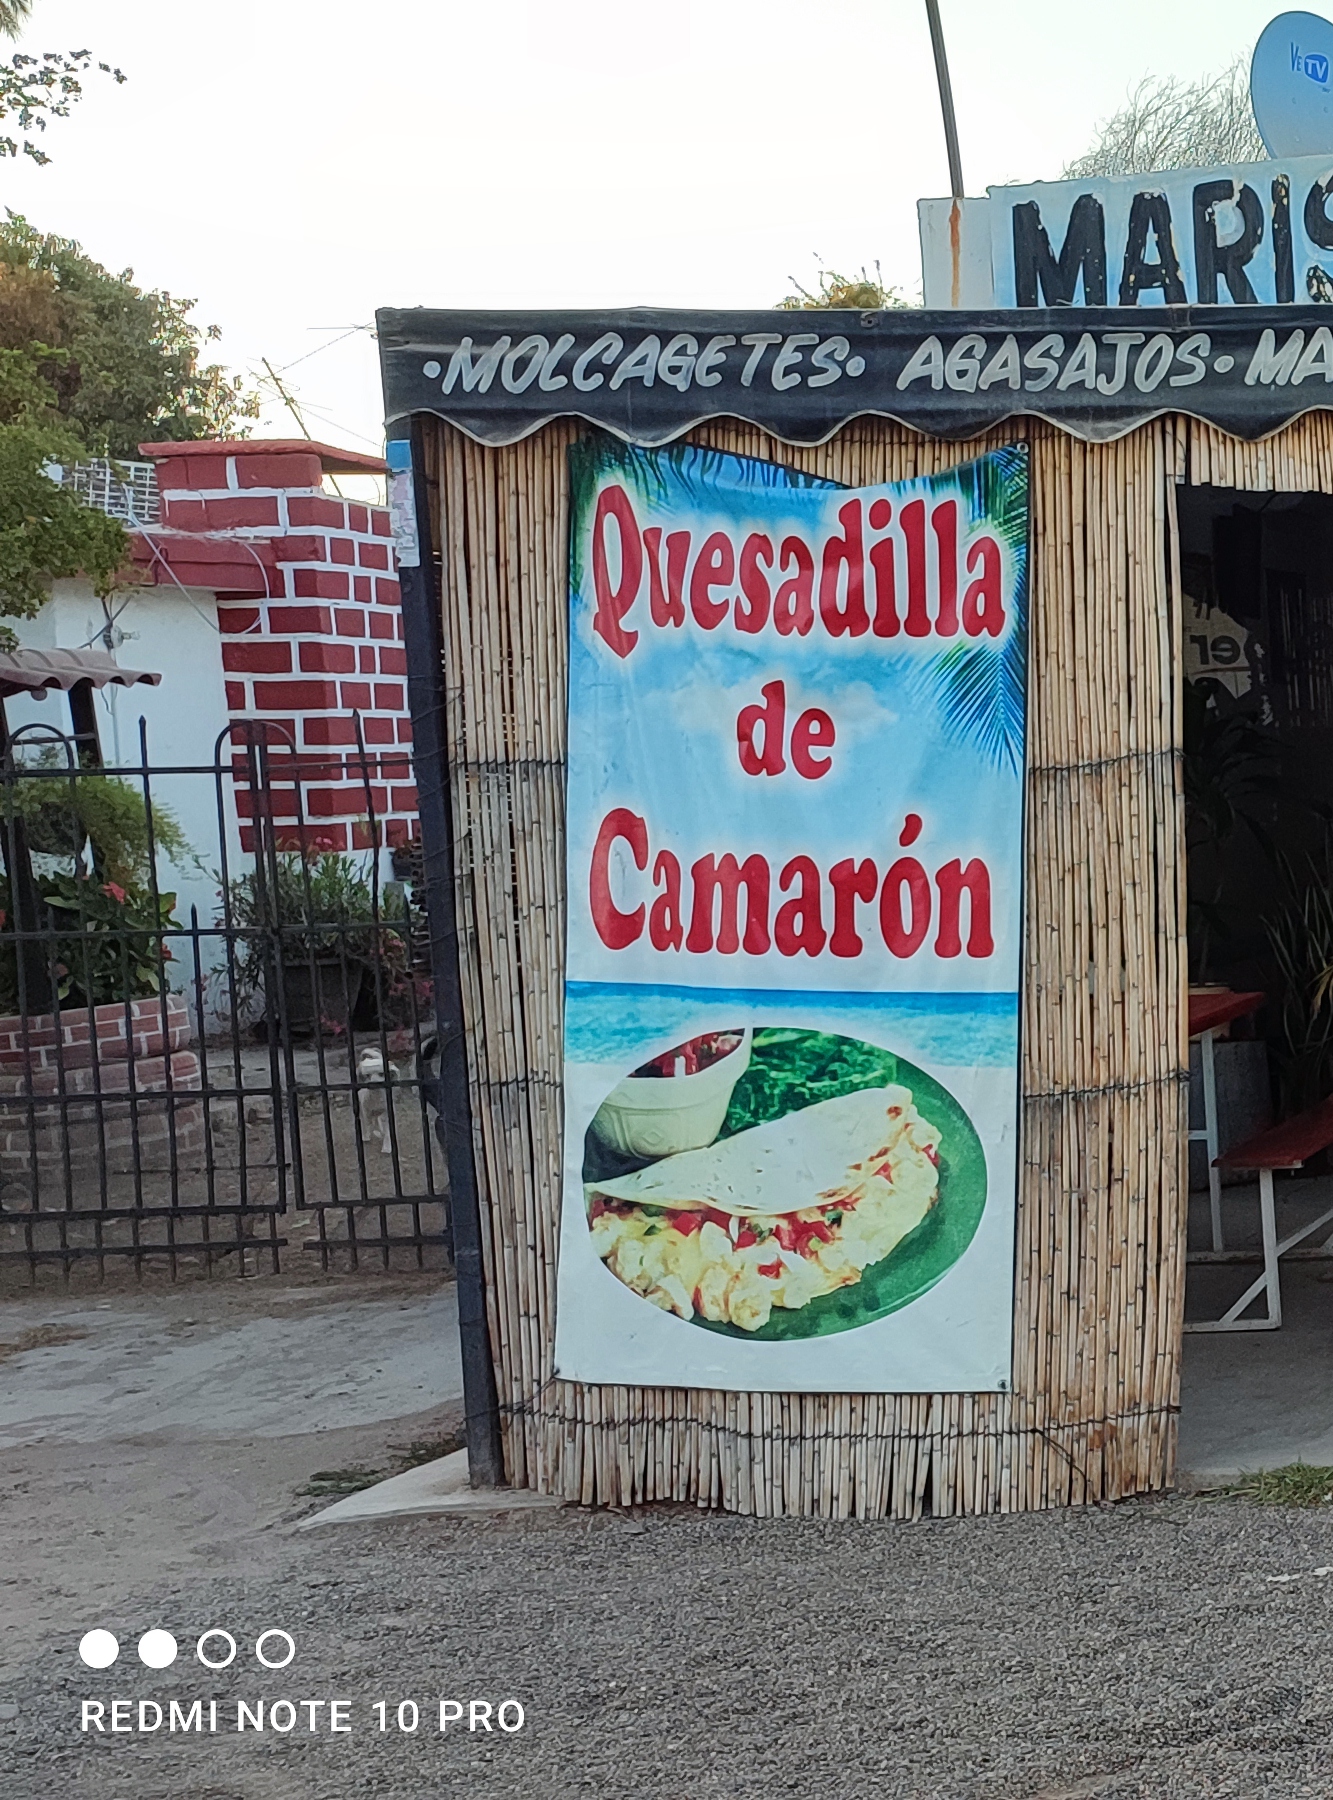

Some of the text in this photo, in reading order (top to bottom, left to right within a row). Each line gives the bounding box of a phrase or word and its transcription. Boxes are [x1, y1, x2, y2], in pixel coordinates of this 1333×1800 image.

[441, 331, 851, 395] MOLCAGETES
[895, 332, 1212, 396] AGASAJOS
[592, 484, 1006, 659] Quesadilla
[736, 679, 836, 779] de
[589, 807, 995, 958] Camarón
